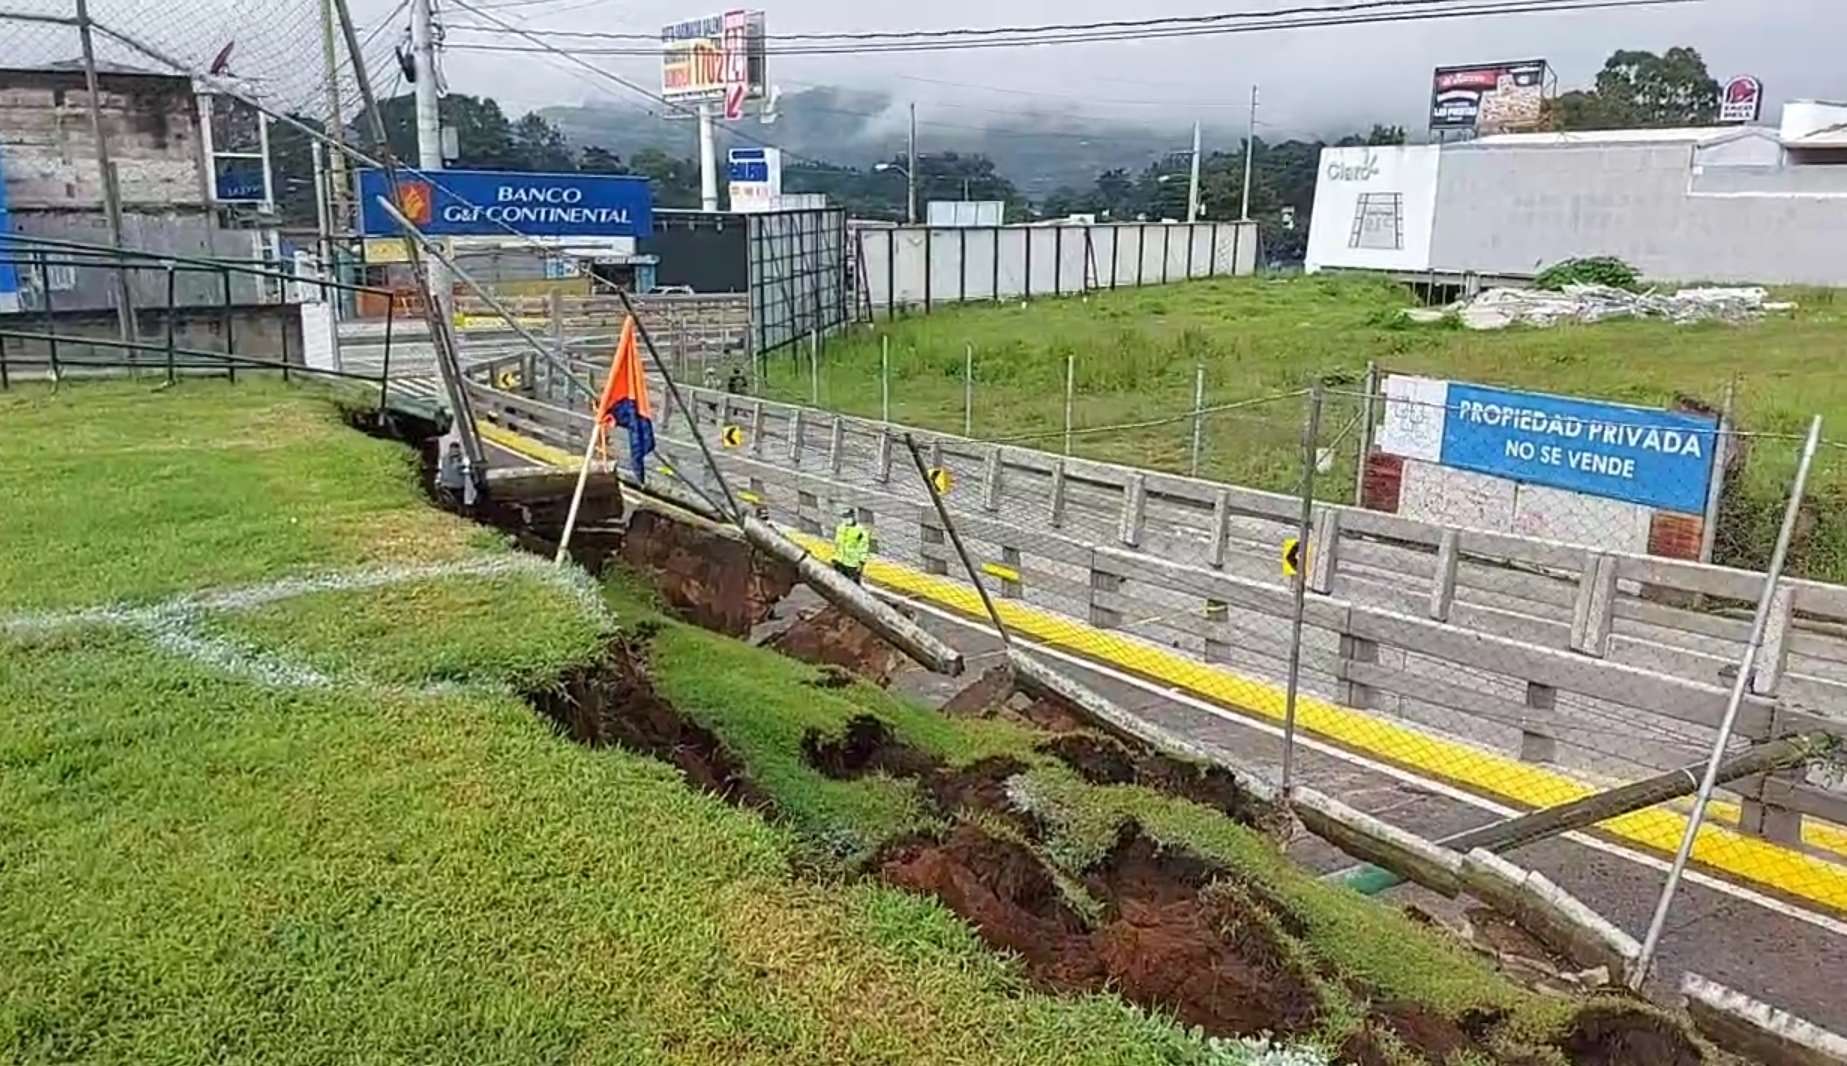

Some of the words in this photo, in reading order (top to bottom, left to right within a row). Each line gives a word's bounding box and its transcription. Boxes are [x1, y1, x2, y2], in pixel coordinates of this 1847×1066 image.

[1327, 163, 1370, 181] Claro
[498, 186, 582, 203] BANCO
[486, 206, 632, 224] CONTINENTAL
[1459, 400, 1581, 438] PROPIEDAD
[1588, 422, 1702, 458] PRIVADA
[1505, 440, 1535, 461] NO
[1540, 445, 1562, 465] SE
[1567, 449, 1636, 479] VENDE
